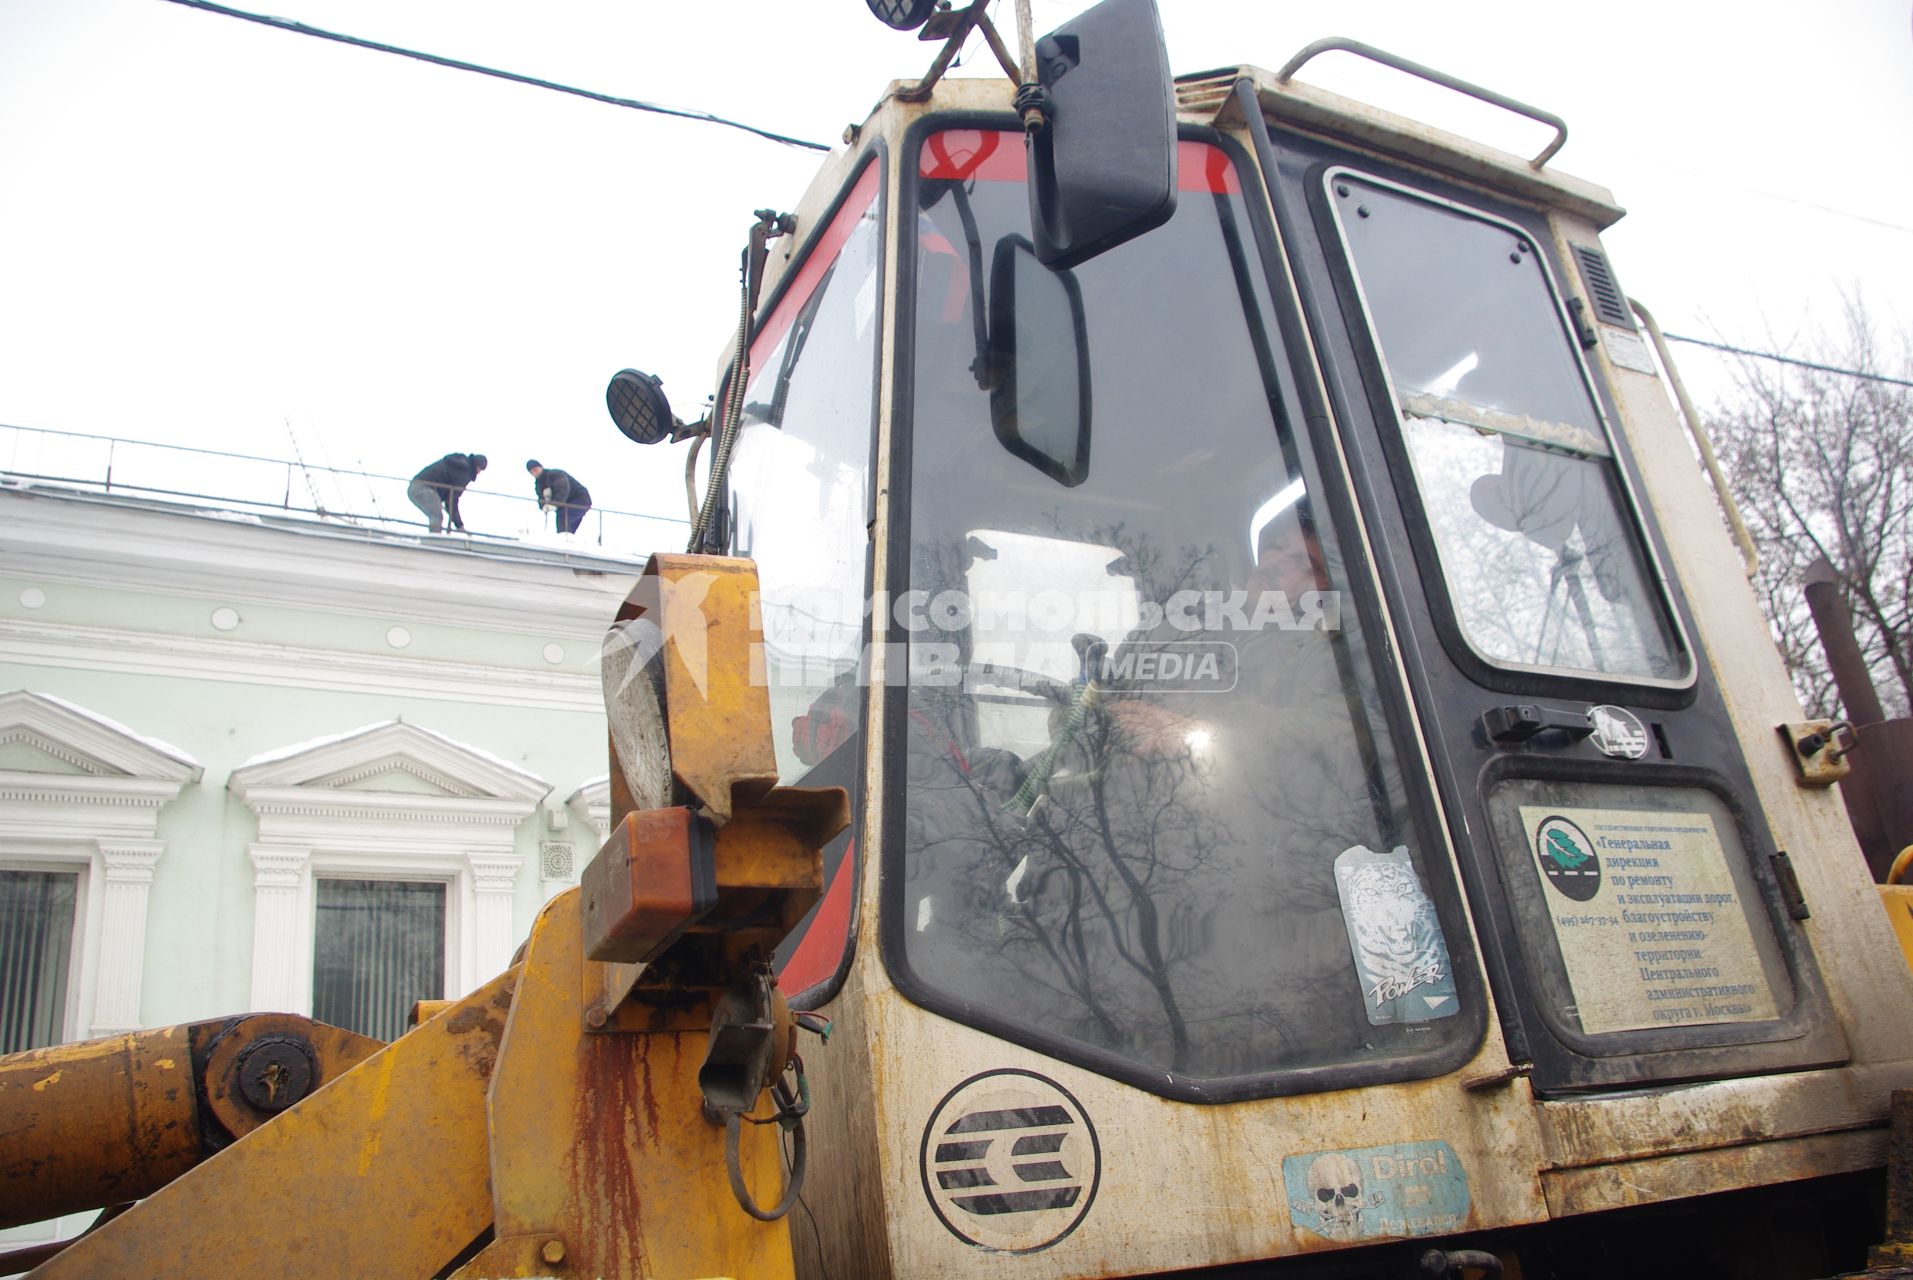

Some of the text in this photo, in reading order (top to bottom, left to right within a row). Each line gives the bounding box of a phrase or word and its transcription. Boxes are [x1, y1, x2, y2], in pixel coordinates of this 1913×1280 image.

[1606, 857, 1659, 870] дирекция
[1611, 876, 1673, 889] по ремонту
[1617, 894, 1626, 904] и
[1628, 893, 1702, 907] эксплуатации
[1557, 915, 1578, 927] (495)
[1622, 909, 1714, 926] благоустройству
[1629, 930, 1705, 943] и озеленению
[1634, 948, 1701, 964] территории
[1640, 966, 1719, 982] Центрального
[1369, 963, 1446, 1008] POWER
[1647, 984, 1755, 1001] административного
[1653, 1007, 1692, 1022] округа
[1373, 1149, 1447, 1179] Dirol
